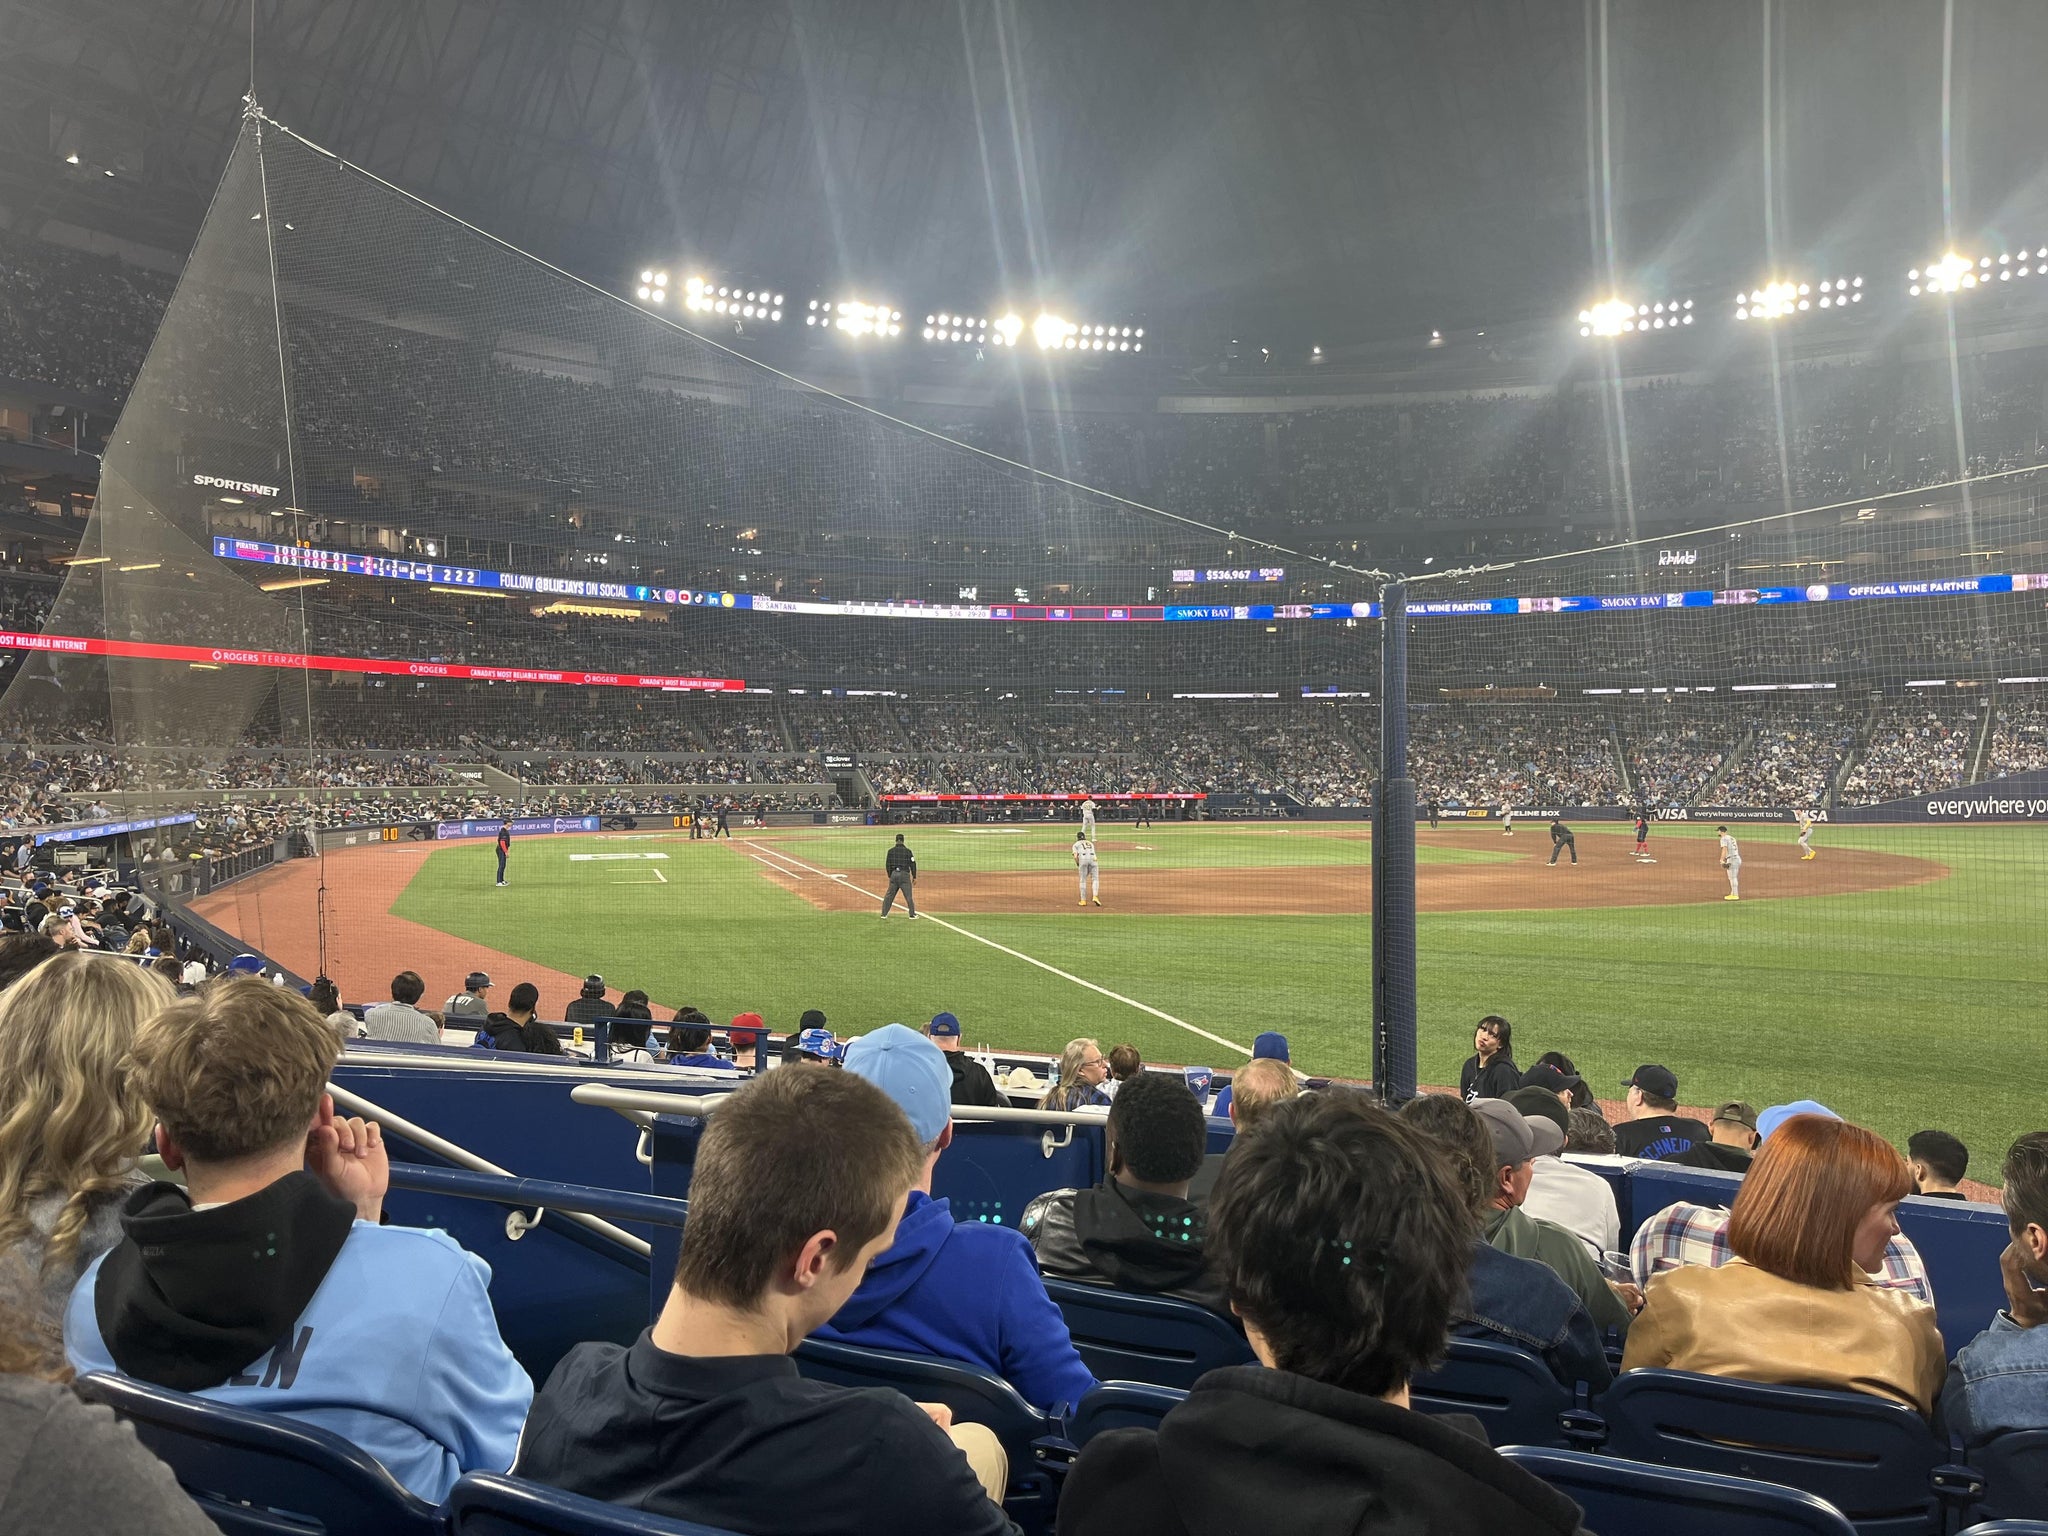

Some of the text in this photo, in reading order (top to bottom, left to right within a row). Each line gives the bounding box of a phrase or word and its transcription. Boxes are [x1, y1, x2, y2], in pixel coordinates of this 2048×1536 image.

[193, 474, 280, 497] SPORTSNET
[235, 541, 259, 551] PIRATES
[1659, 551, 1696, 565] KPMG
[444, 569, 475, 583] 2 2 2
[500, 573, 533, 590] FOLLOW
[535, 577, 584, 595] @BLUEJAYS
[585, 582, 598, 596] ON
[599, 583, 629, 598] SOCIAL
[1849, 581, 1979, 596] OFFICIAL WINE PARTNER
[766, 601, 797, 611] SANTANA
[1405, 603, 1492, 613] CIAL WINE PARTNER
[1601, 598, 1638, 607] SMOKY
[1640, 597, 1661, 606] BAY
[1177, 609, 1209, 617] SMOKY
[1212, 609, 1230, 617] BAY
[0, 635, 87, 650] OST RELIABLE INTERNET
[223, 652, 307, 666] ROGERS TERRACE
[418, 665, 448, 674] ROGERS
[470, 668, 496, 677] CANADA'S
[513, 671, 537, 679] RELIABLE
[538, 672, 563, 680] INTERNET
[591, 675, 618, 683] ROGERS
[639, 677, 664, 685] CANADA'S
[680, 679, 701, 687] RELIABLE
[702, 680, 725, 688] INTERNET
[1657, 808, 1688, 819] VISA
[1927, 796, 2048, 819] everywhere yo
[1638, 1137, 1693, 1161] SCHNEID
